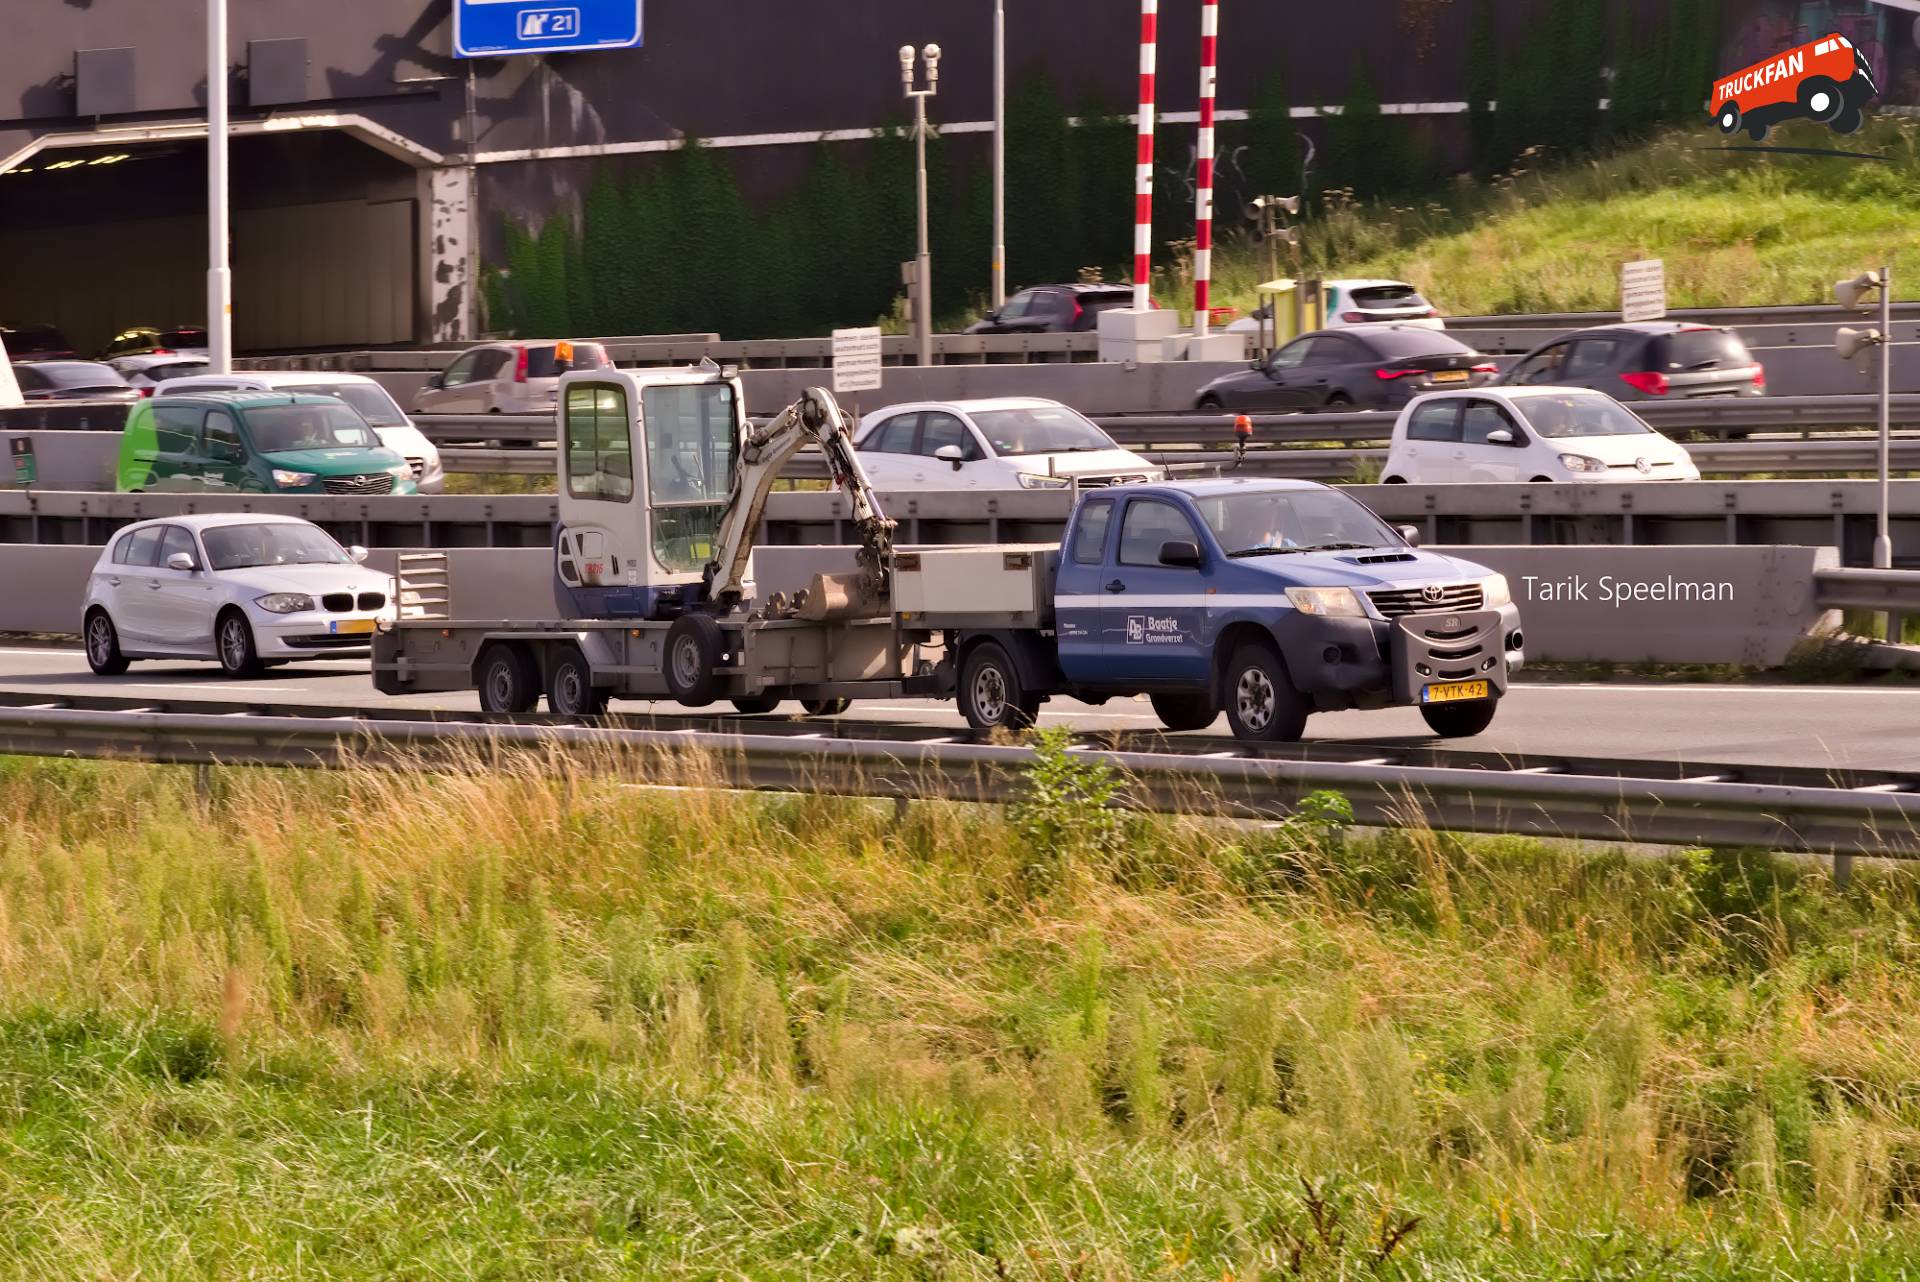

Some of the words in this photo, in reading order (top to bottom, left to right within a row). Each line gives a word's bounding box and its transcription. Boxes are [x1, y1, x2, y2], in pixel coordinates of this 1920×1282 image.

[552, 15, 572, 31] 21
[1147, 616, 1178, 632] Baatje
[1432, 683, 1483, 700] 7-VTK-42
